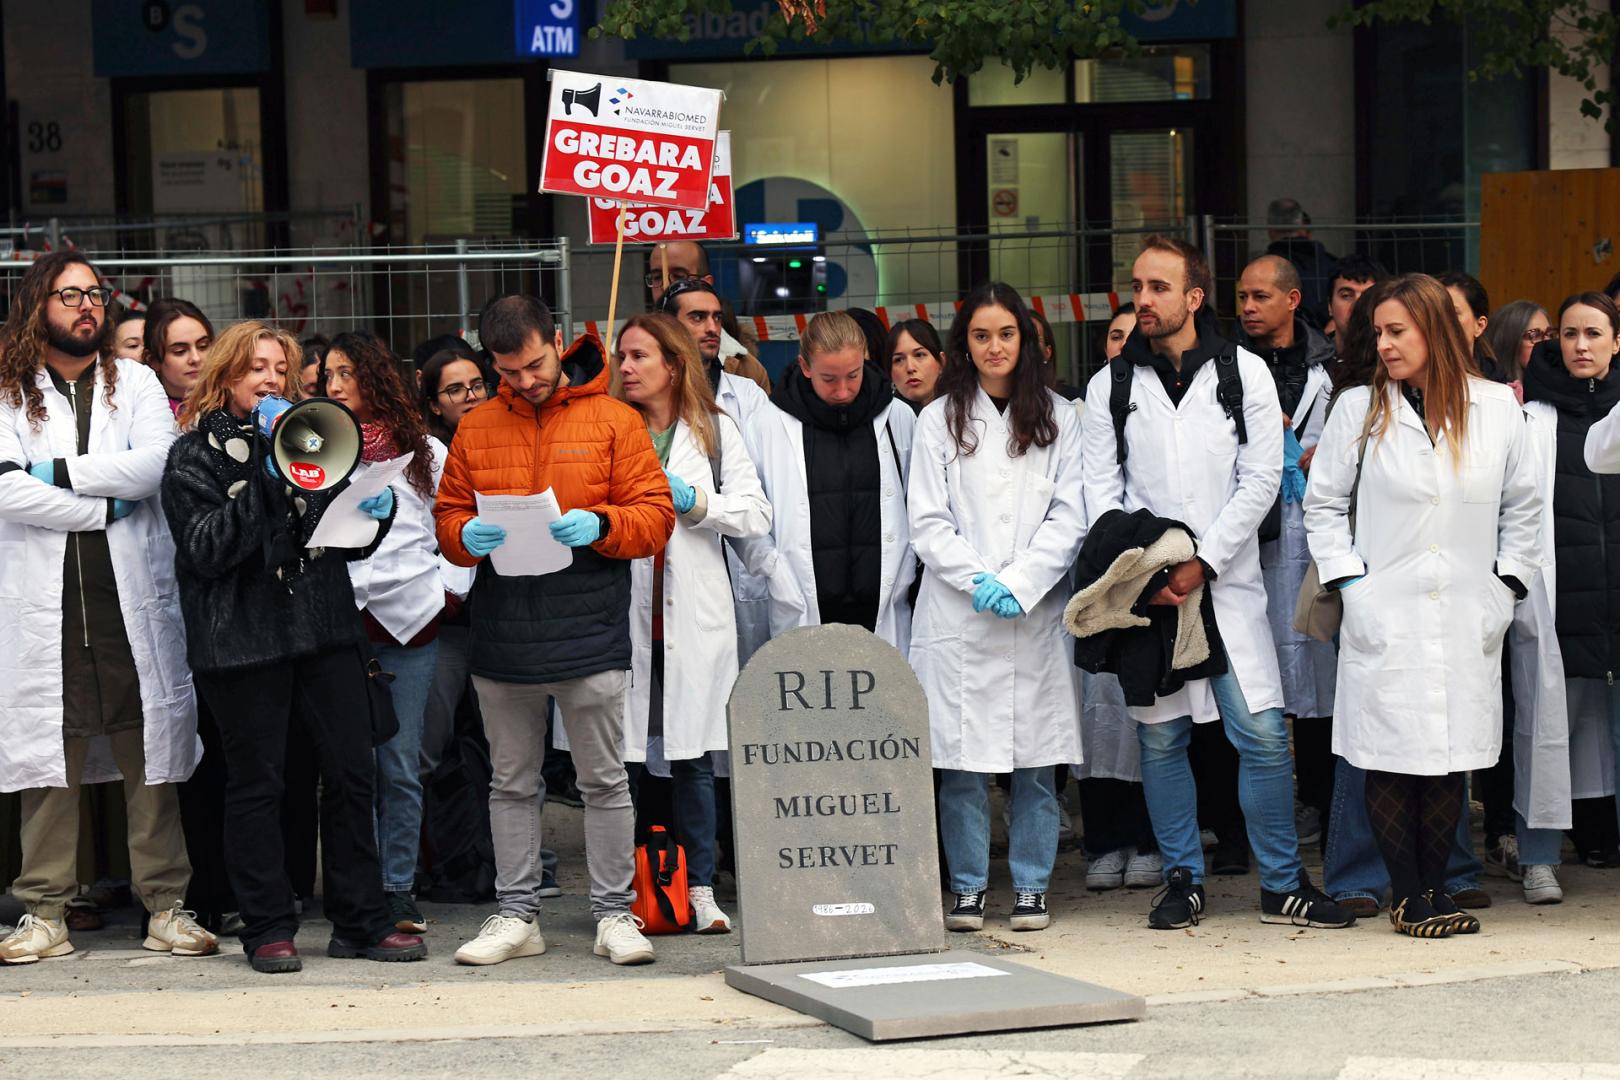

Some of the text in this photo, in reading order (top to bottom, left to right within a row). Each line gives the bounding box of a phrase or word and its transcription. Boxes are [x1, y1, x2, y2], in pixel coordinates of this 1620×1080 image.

[172, 4, 207, 60] S
[530, 25, 574, 55] ATM
[624, 117, 706, 132] FUNDACIÓN MIGUEL SERVET
[625, 106, 707, 124] NAVARRABIOMED
[28, 121, 62, 153] 38
[554, 129, 702, 171] GREBARA
[573, 160, 679, 199] GOAZ
[615, 209, 707, 237] GOAZ
[291, 465, 321, 479] LAB
[774, 669, 877, 711] RIP
[742, 734, 921, 766] FUNDACIÓN
[773, 792, 901, 819] MIGUEL
[778, 844, 899, 870] SERVET
